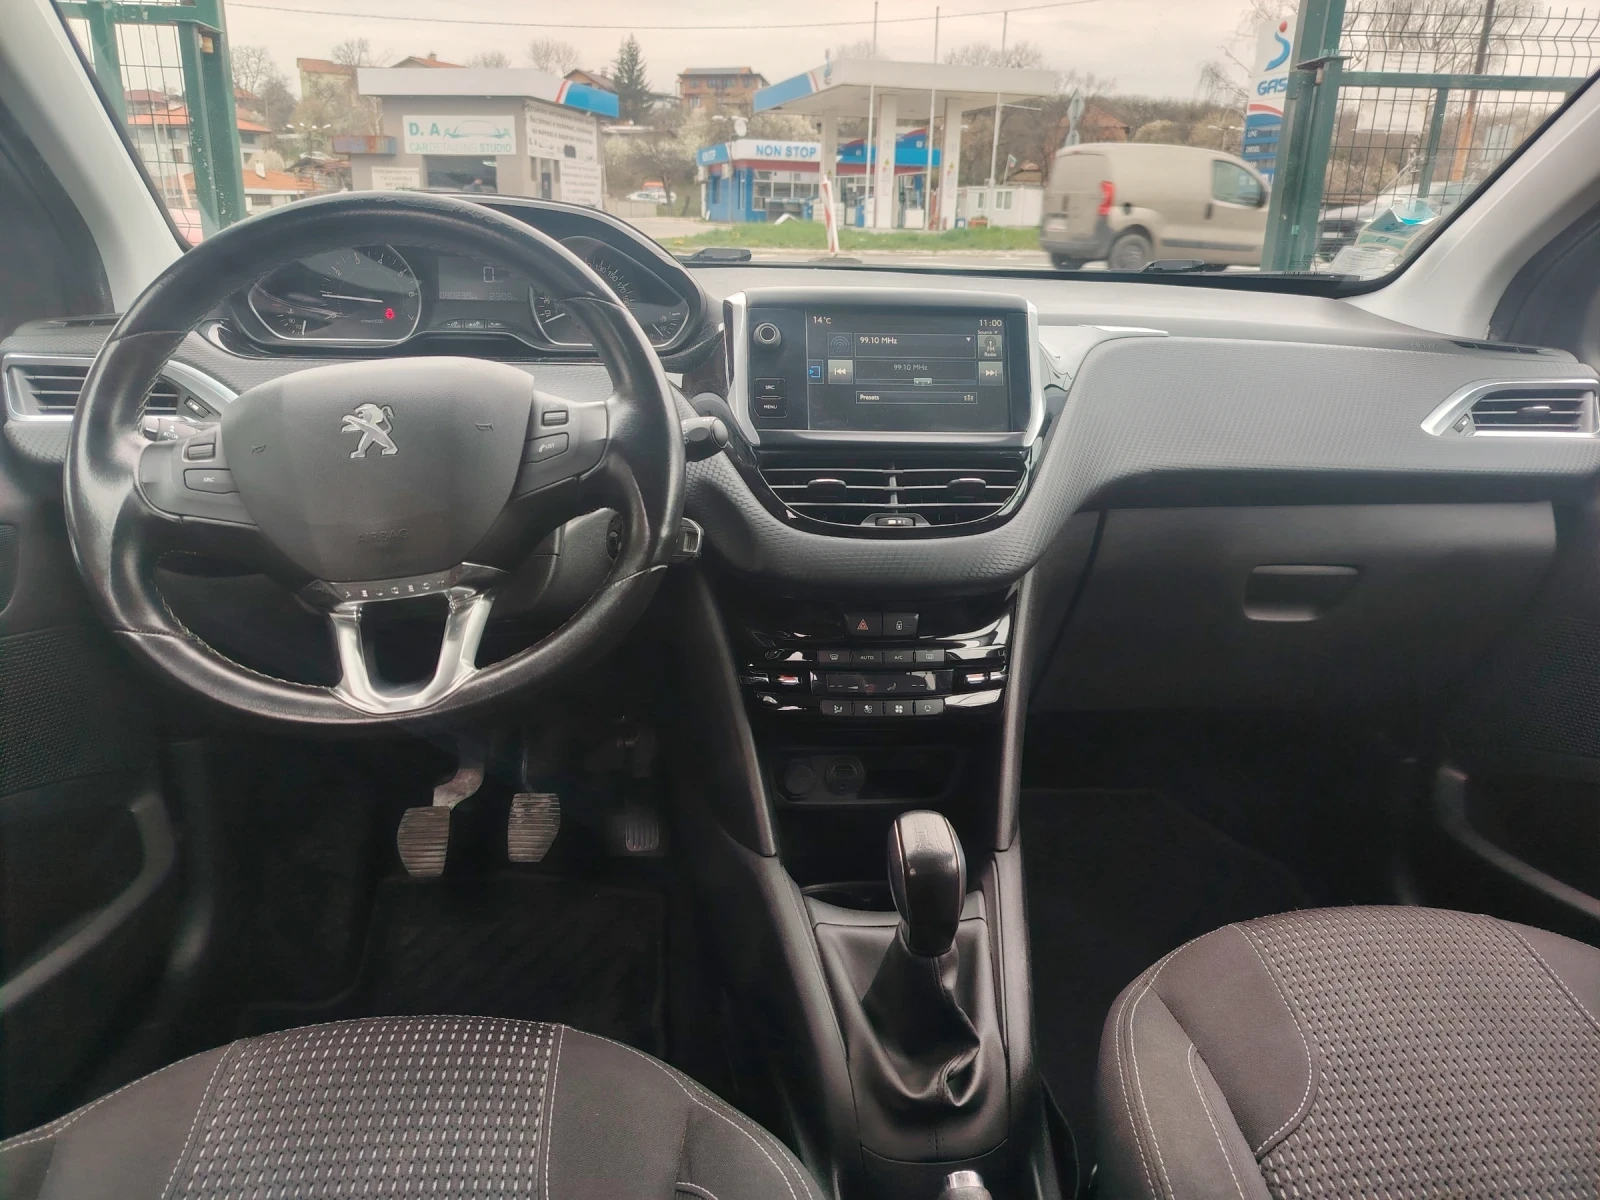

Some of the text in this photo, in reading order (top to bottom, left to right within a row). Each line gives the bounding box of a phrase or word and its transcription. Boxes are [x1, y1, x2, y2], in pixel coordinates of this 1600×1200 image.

[430, 122, 440, 136] A
[480, 143, 512, 153] STUDIO
[756, 145, 817, 157] NON STOP
[860, 336, 880, 344] 99.10
